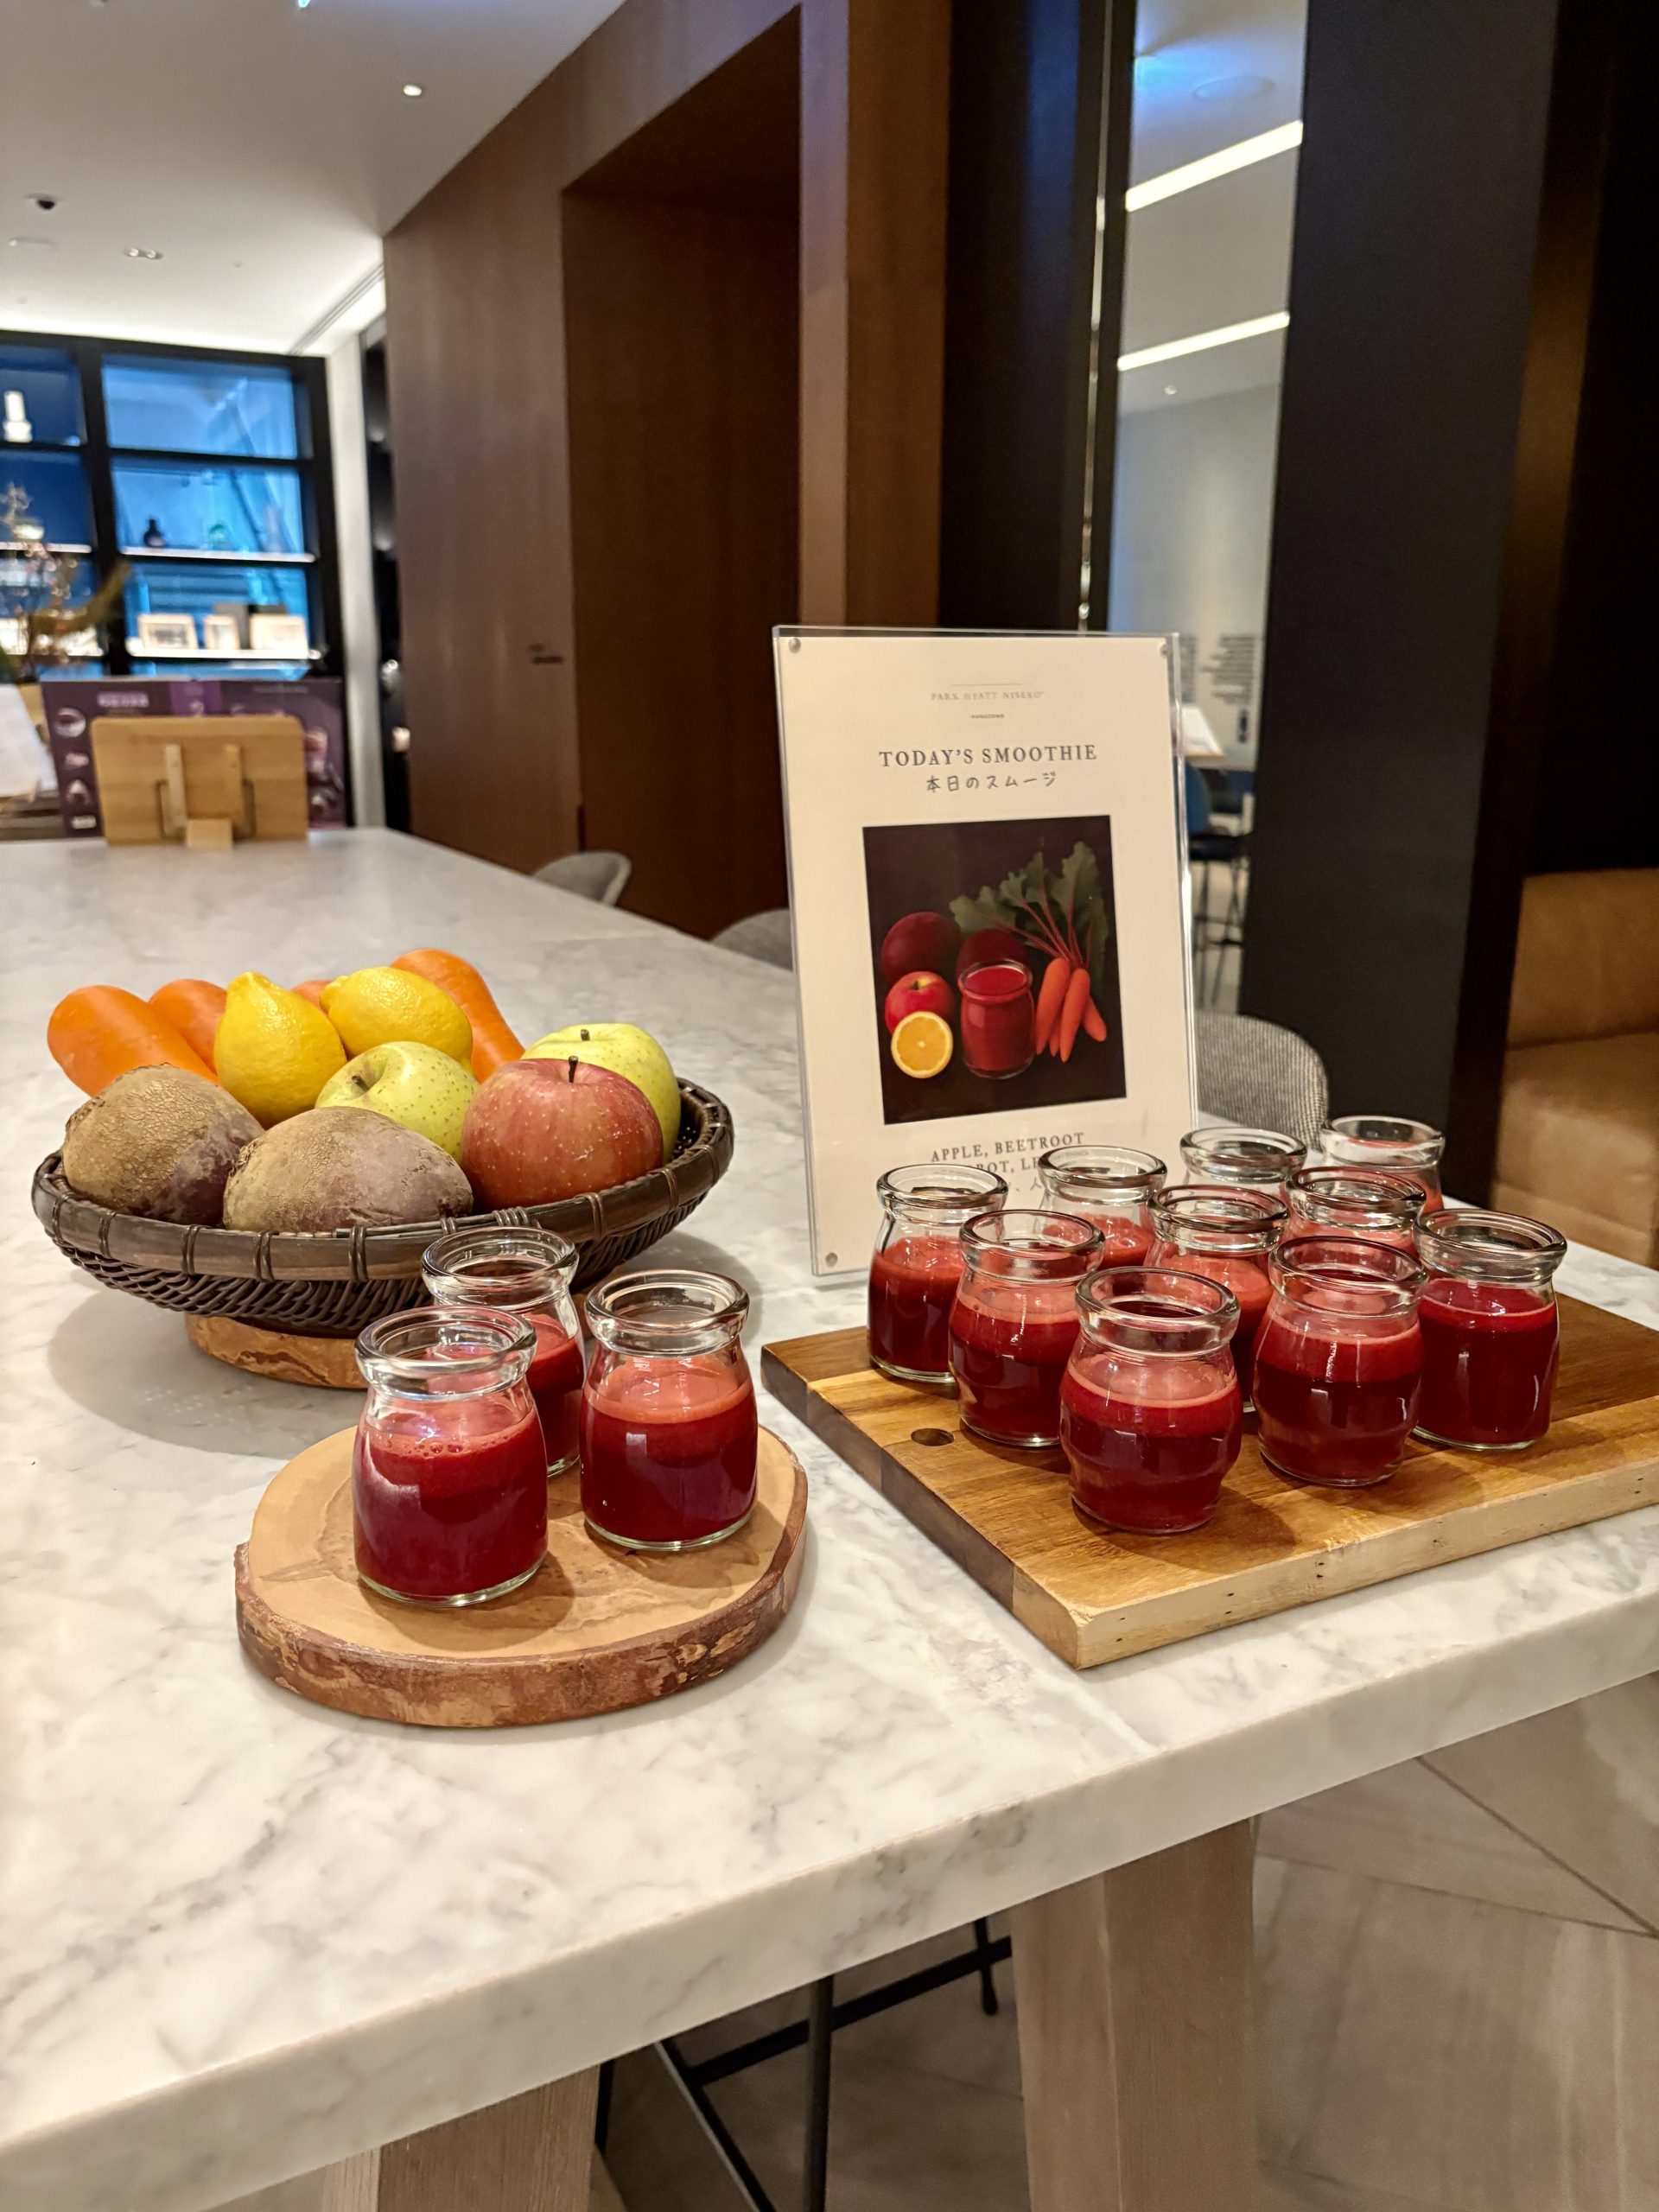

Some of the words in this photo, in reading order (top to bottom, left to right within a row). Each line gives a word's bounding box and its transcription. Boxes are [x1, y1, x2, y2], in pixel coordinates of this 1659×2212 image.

[930, 692, 960, 701] PARK
[982, 745, 1097, 765] SMOOTHIE
[925, 771, 1056, 793] 本日のスムージ
[931, 1145, 988, 1163] APPLE,
[995, 1132, 1085, 1154] BEETROOT
